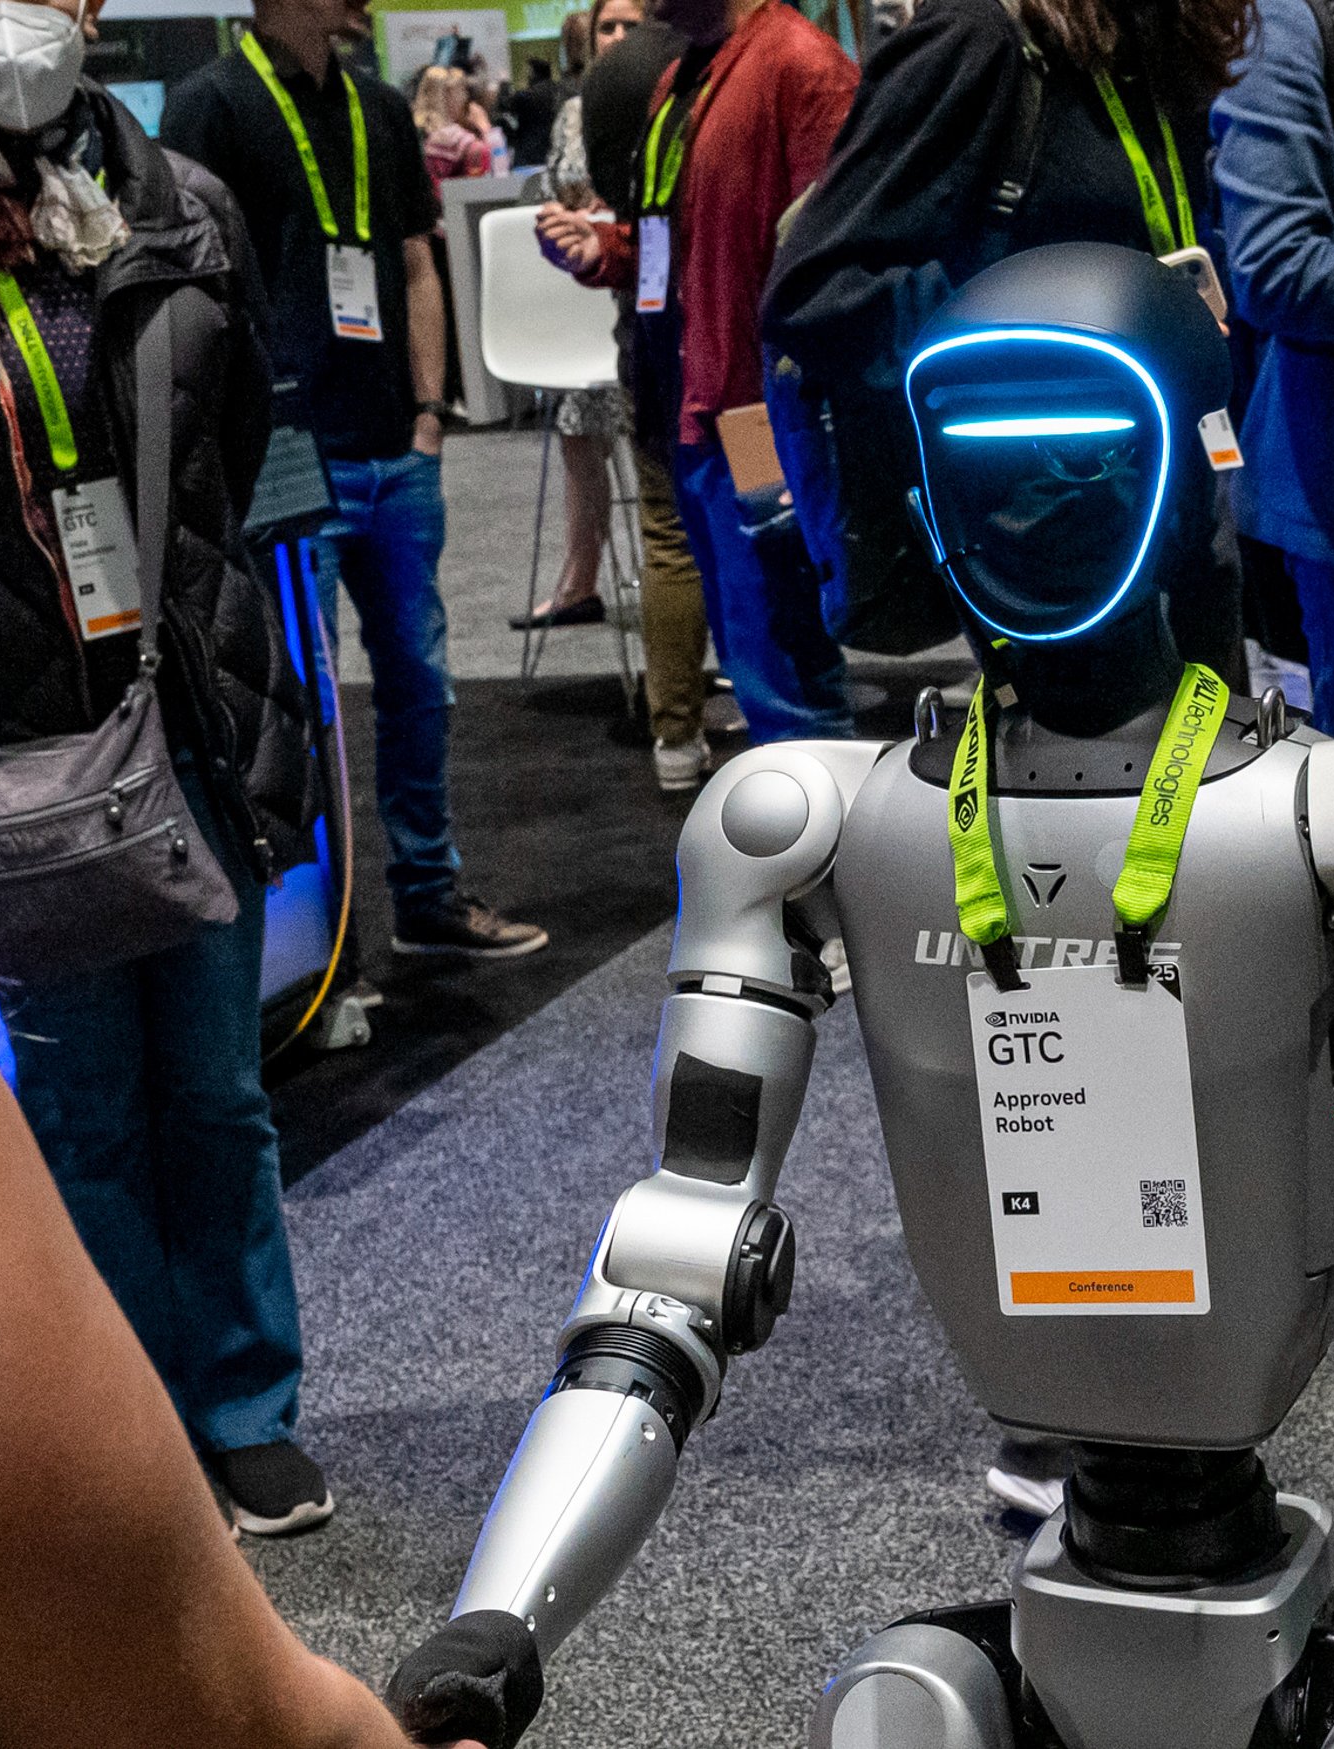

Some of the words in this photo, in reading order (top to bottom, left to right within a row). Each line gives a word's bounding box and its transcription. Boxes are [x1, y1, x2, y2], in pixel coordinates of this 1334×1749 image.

[64, 510, 98, 532] GTC
[959, 701, 981, 789] NVIDIA
[1150, 700, 1215, 827] Technologies
[915, 929, 1183, 969] UNTRE
[1151, 964, 1176, 981] 25
[1009, 1011, 1060, 1025] NVIDIA
[988, 1031, 1065, 1066] GTC
[993, 1087, 1086, 1111] Approved
[995, 1115, 1055, 1133] Robot
[1011, 1197, 1032, 1211] K4
[1068, 1281, 1135, 1293] Conference
